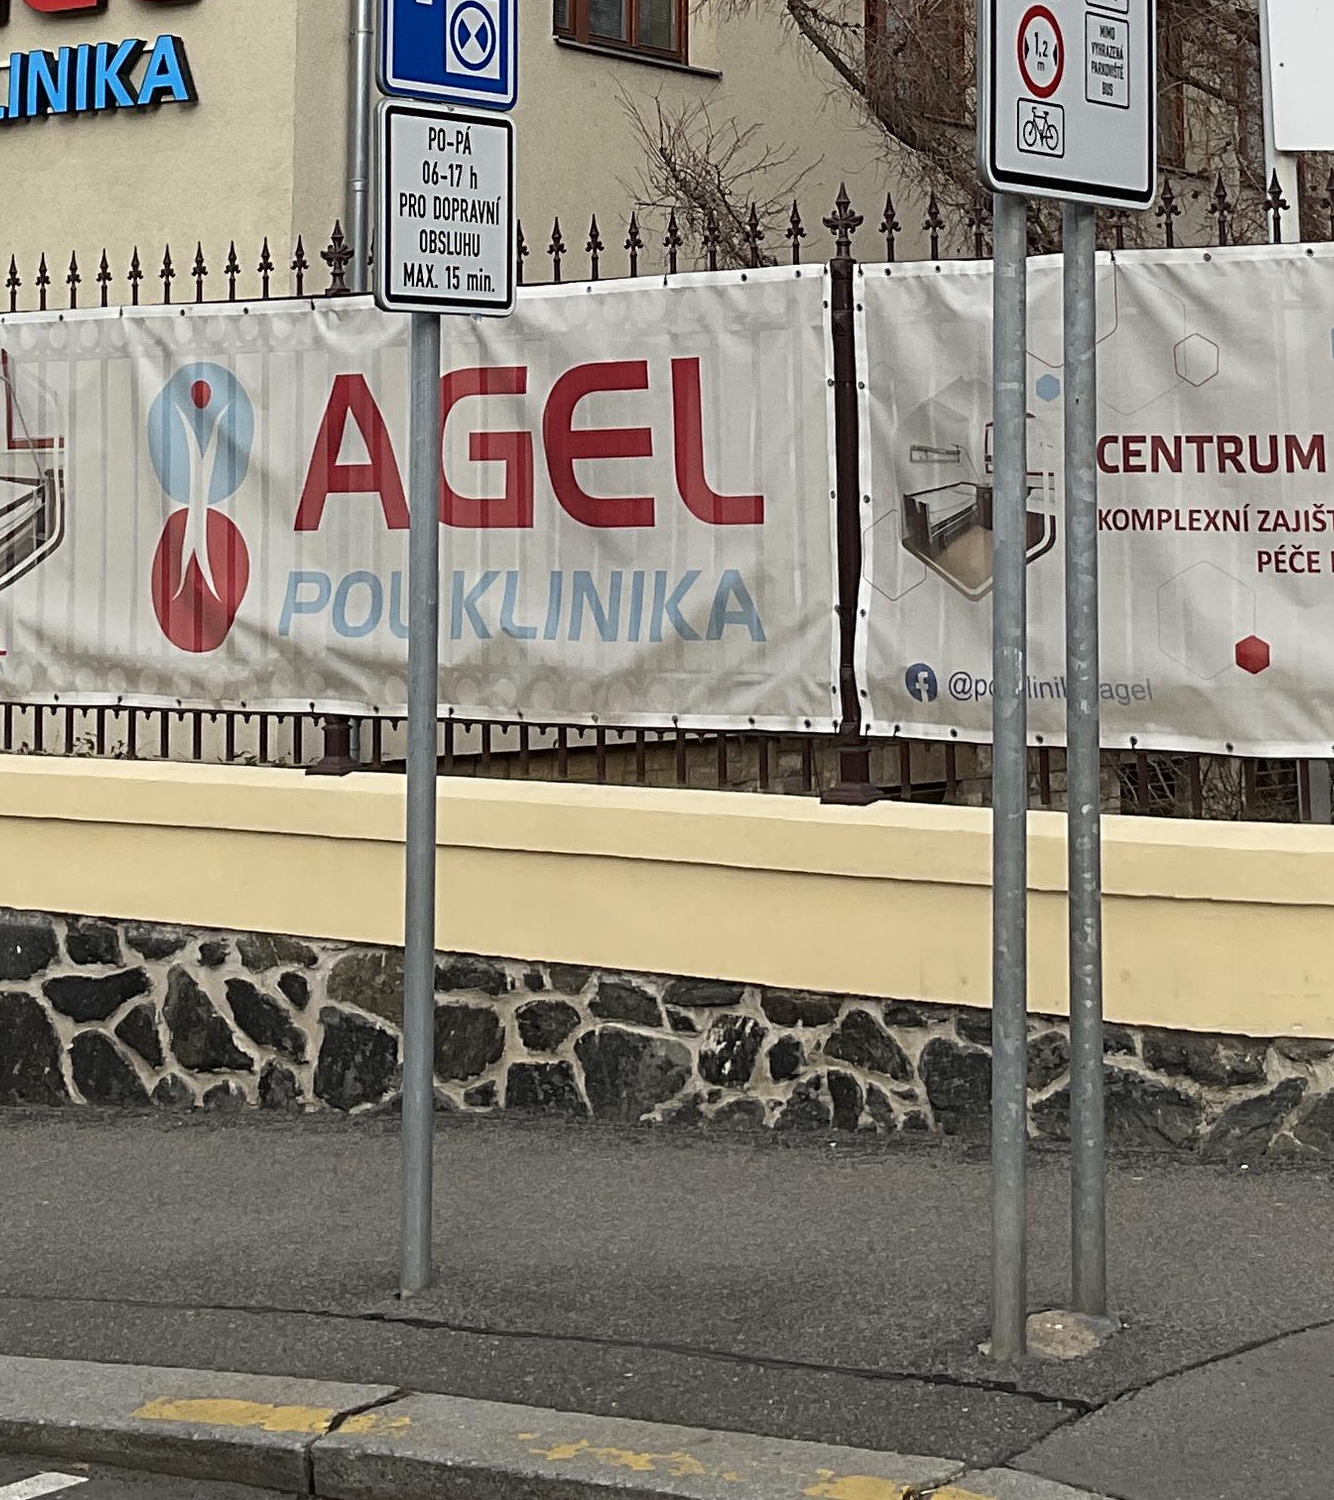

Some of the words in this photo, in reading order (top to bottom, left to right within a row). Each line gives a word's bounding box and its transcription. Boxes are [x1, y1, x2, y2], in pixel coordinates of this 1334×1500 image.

[1034, 31, 1048, 58] 1,2
[1036, 60, 1045, 71] m
[428, 126, 472, 155] PO-PÁ
[423, 161, 463, 188] 06-17
[469, 165, 478, 190] h
[399, 192, 426, 219] PRO
[433, 196, 501, 225] DOPRAVNÍ
[419, 229, 481, 257] OBSLUHU
[403, 262, 439, 289] MAX.
[445, 266, 460, 290] 15
[467, 268, 496, 293] min.
[294, 356, 765, 531] AGEL
[1096, 434, 1326, 474] CENTRUM
[1097, 504, 1251, 533] KOMPLEXNÍ
[1256, 544, 1322, 574] PÉČE
[278, 569, 767, 643] POLKLINIKA
